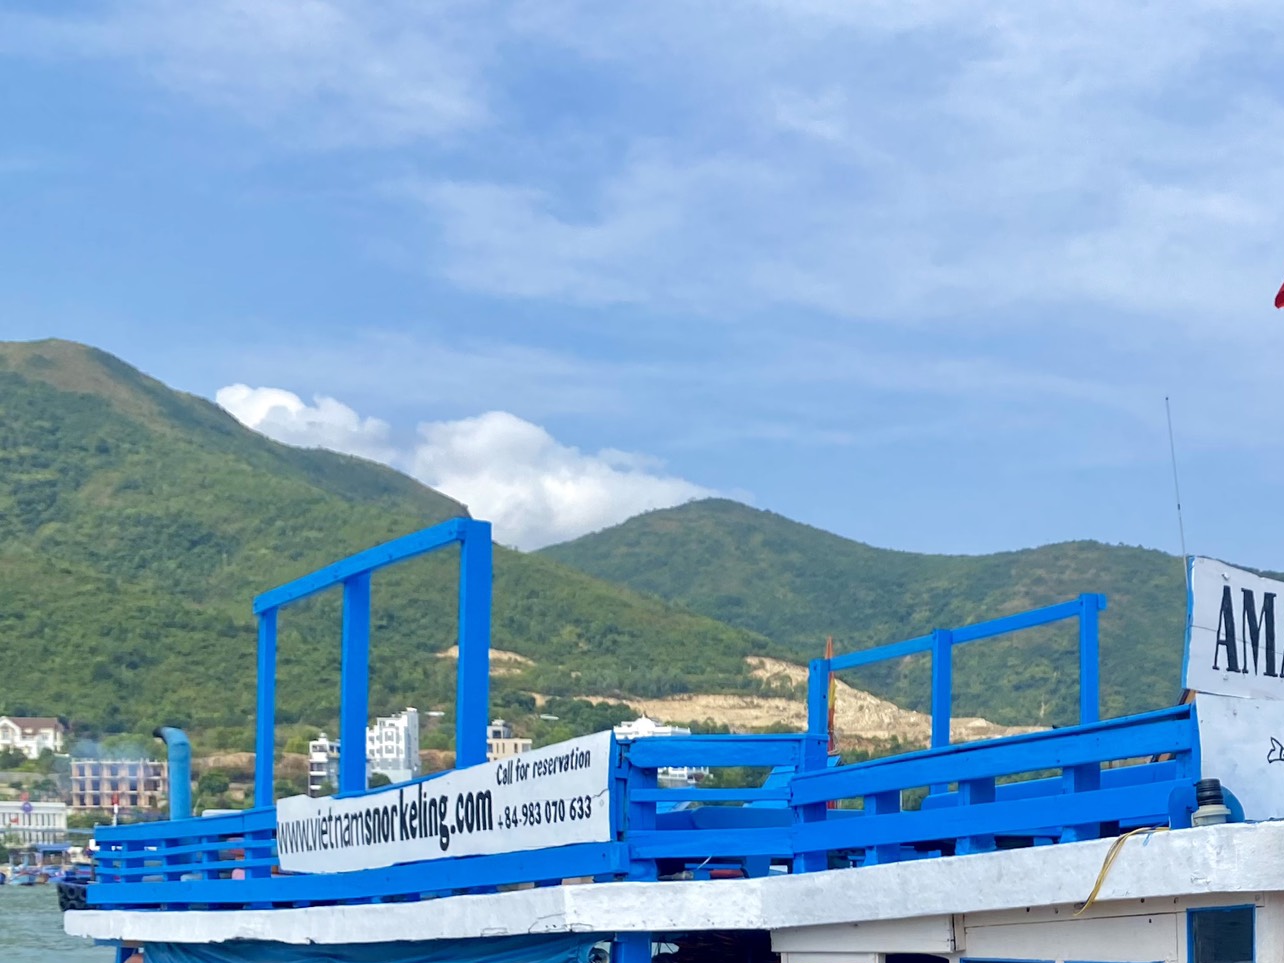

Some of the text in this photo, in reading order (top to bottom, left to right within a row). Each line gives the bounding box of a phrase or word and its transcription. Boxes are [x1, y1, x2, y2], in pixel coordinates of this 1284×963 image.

[497, 747, 590, 785] Call for reservation
[277, 782, 493, 851] www.vietnamsnorkeling.com
[545, 799, 565, 823] 070
[570, 795, 592, 820] 633
